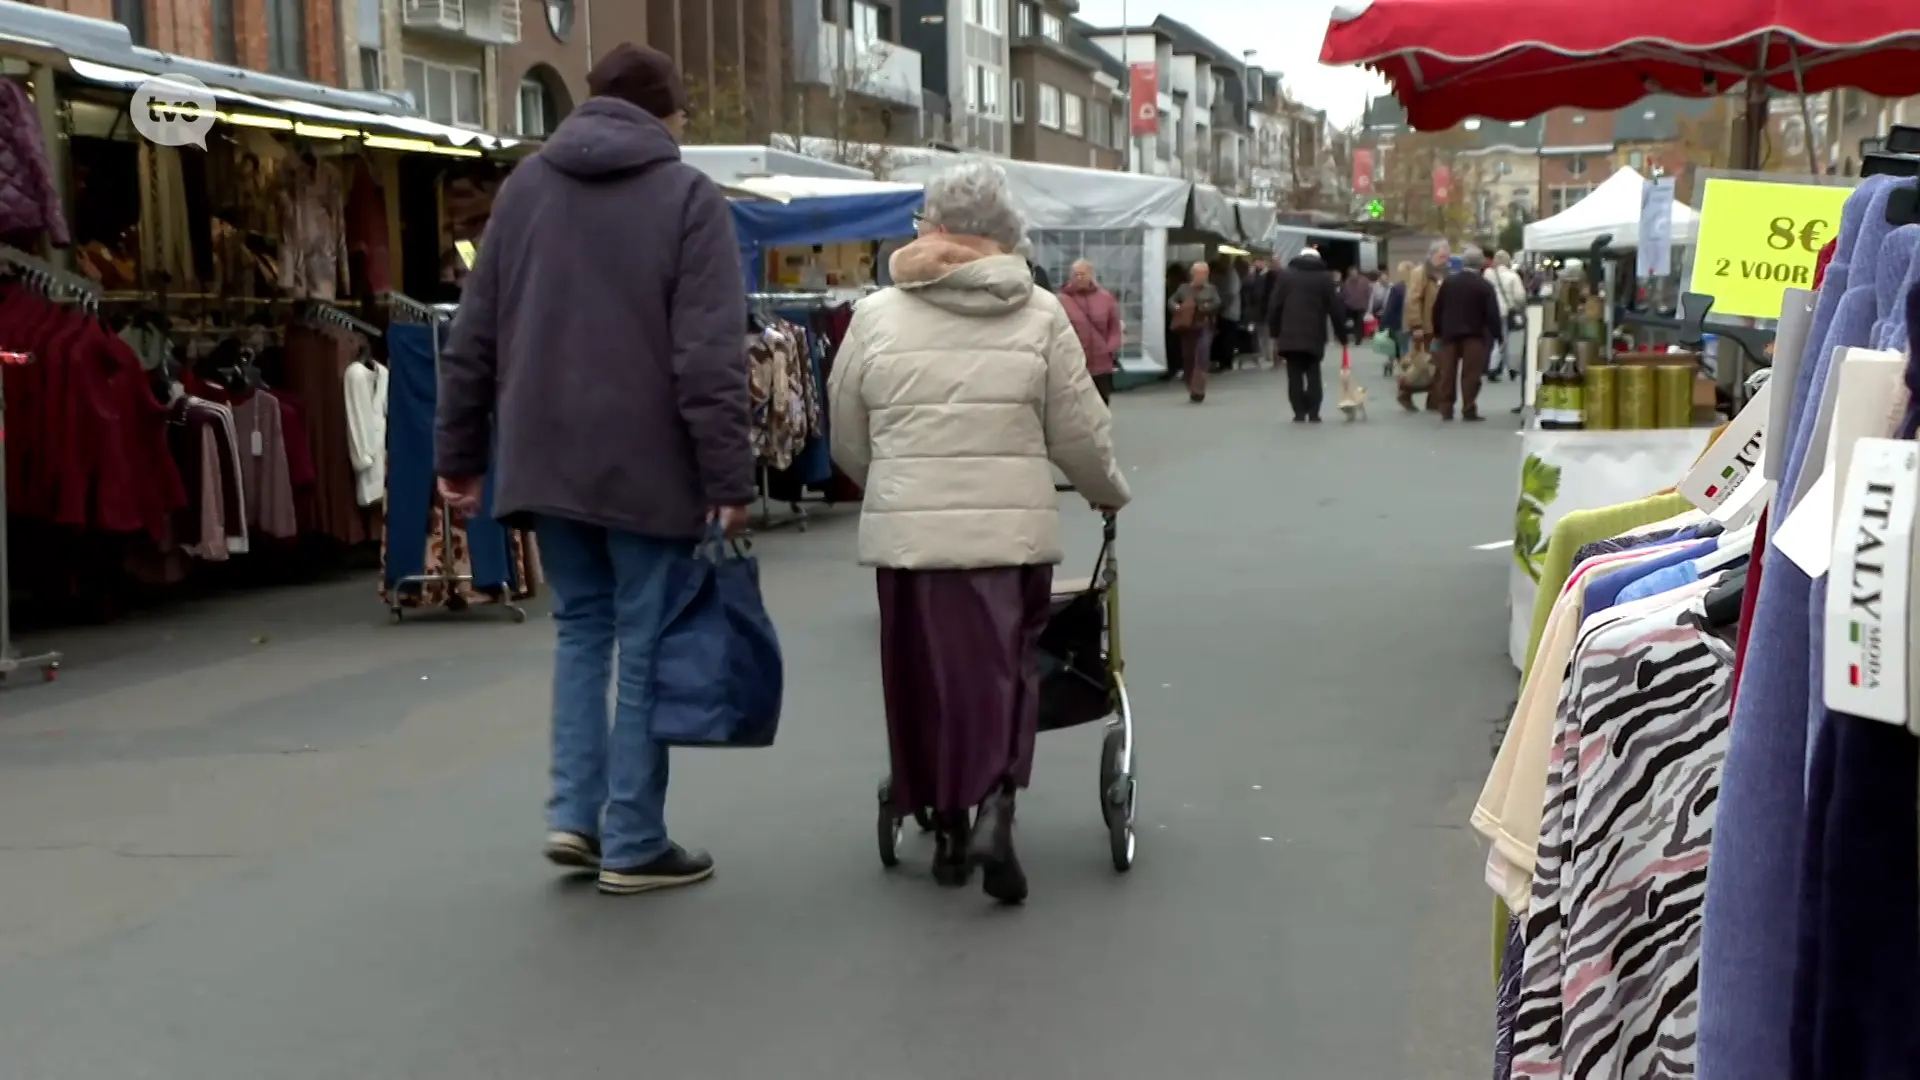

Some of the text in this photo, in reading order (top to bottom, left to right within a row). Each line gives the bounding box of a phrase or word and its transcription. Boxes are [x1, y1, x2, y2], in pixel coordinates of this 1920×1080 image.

[1766, 216, 1828, 254] 8€
[1714, 257, 1810, 285] 2 VOOR
[1850, 480, 1895, 690] ITALY MODA
